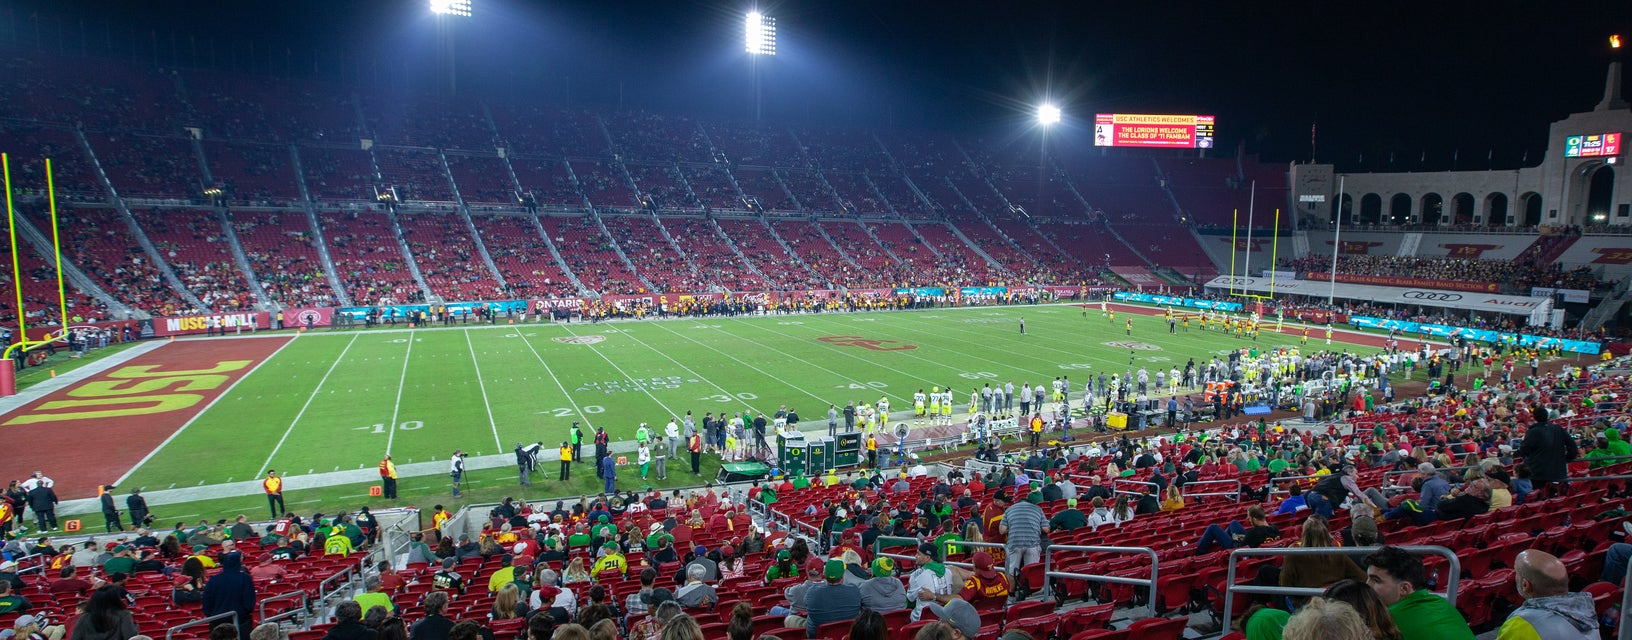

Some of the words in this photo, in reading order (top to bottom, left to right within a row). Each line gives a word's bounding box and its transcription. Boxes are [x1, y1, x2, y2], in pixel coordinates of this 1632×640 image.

[1483, 299, 1536, 308] Audi
[958, 371, 998, 380] 50
[849, 381, 888, 391] 40
[0, 360, 254, 427] USC
[710, 392, 759, 403] 30
[552, 405, 606, 418] 20
[371, 420, 425, 434] 10
[371, 487, 380, 495] 10
[67, 521, 77, 530] G
[604, 559, 618, 570] 24
